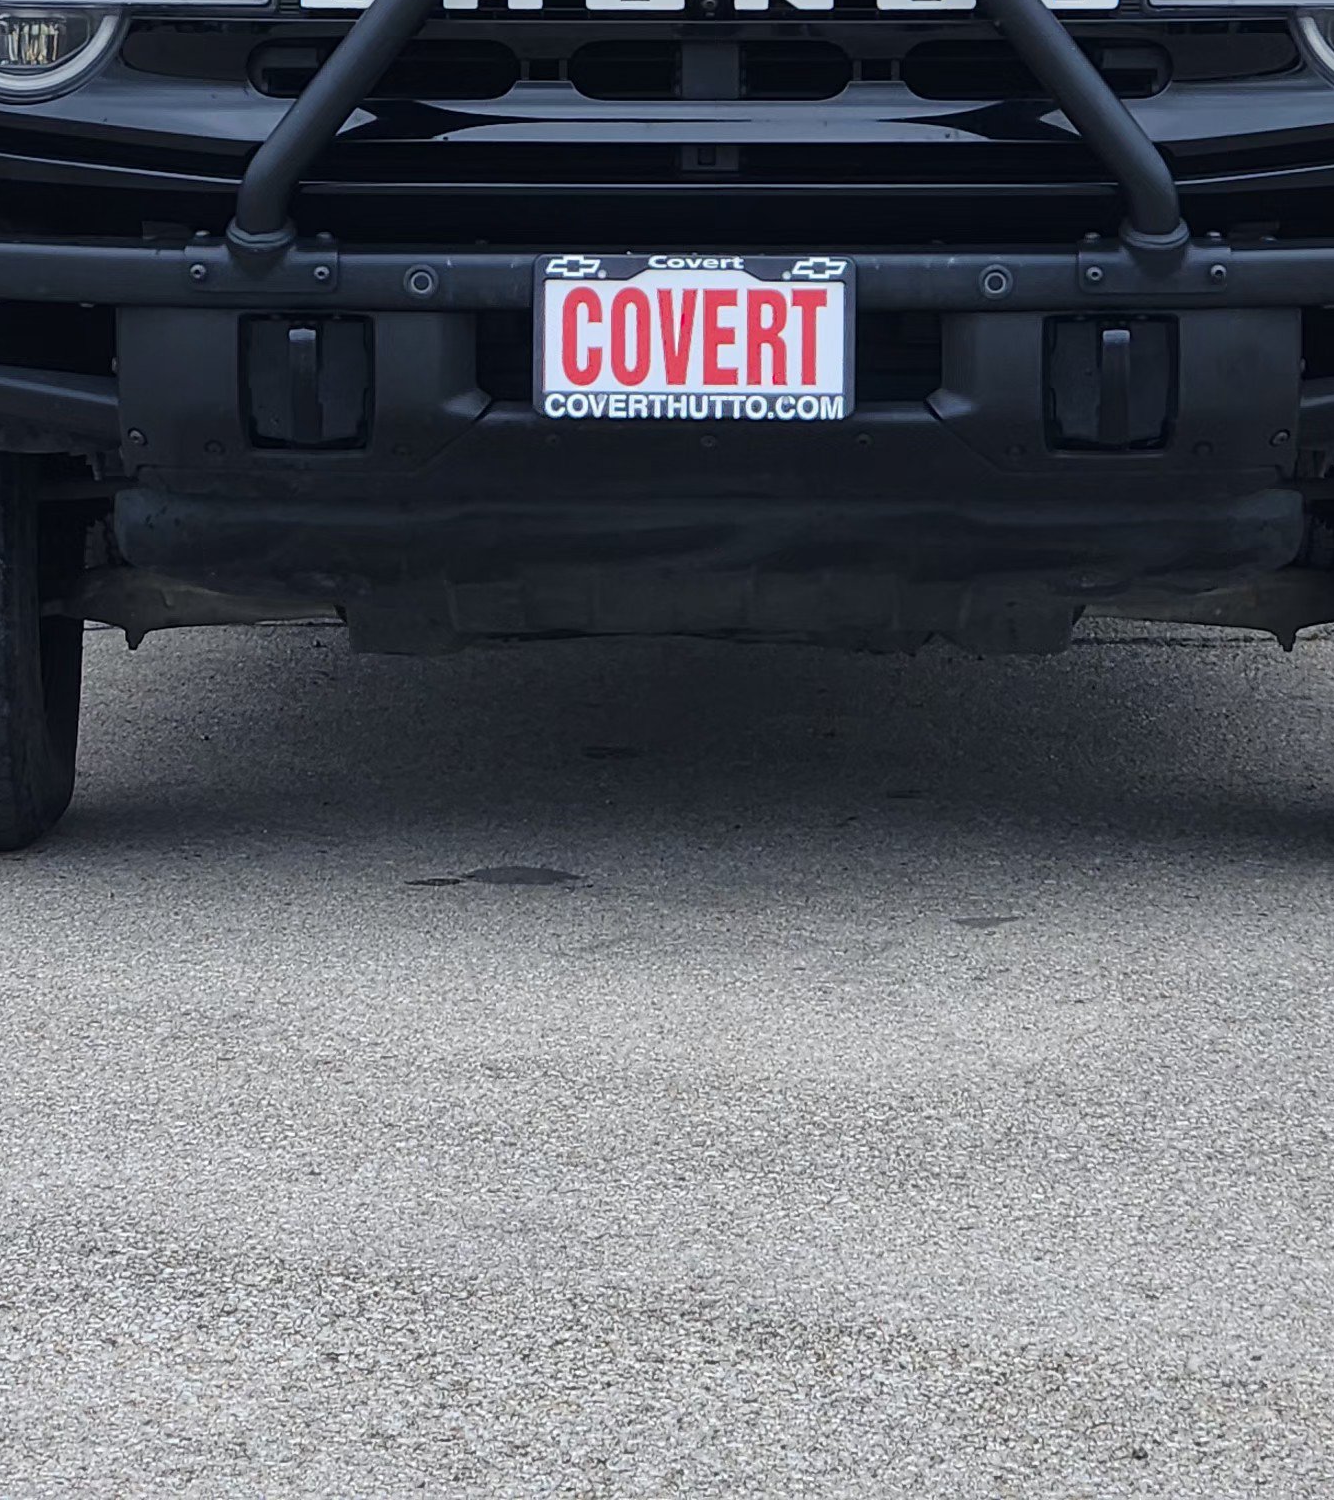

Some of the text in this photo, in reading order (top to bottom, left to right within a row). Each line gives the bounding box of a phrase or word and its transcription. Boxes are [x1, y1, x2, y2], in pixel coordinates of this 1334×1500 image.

[648, 254, 745, 270] Covert
[562, 286, 827, 386] COVERT
[544, 392, 844, 420] COVERTHUTTO.COM
